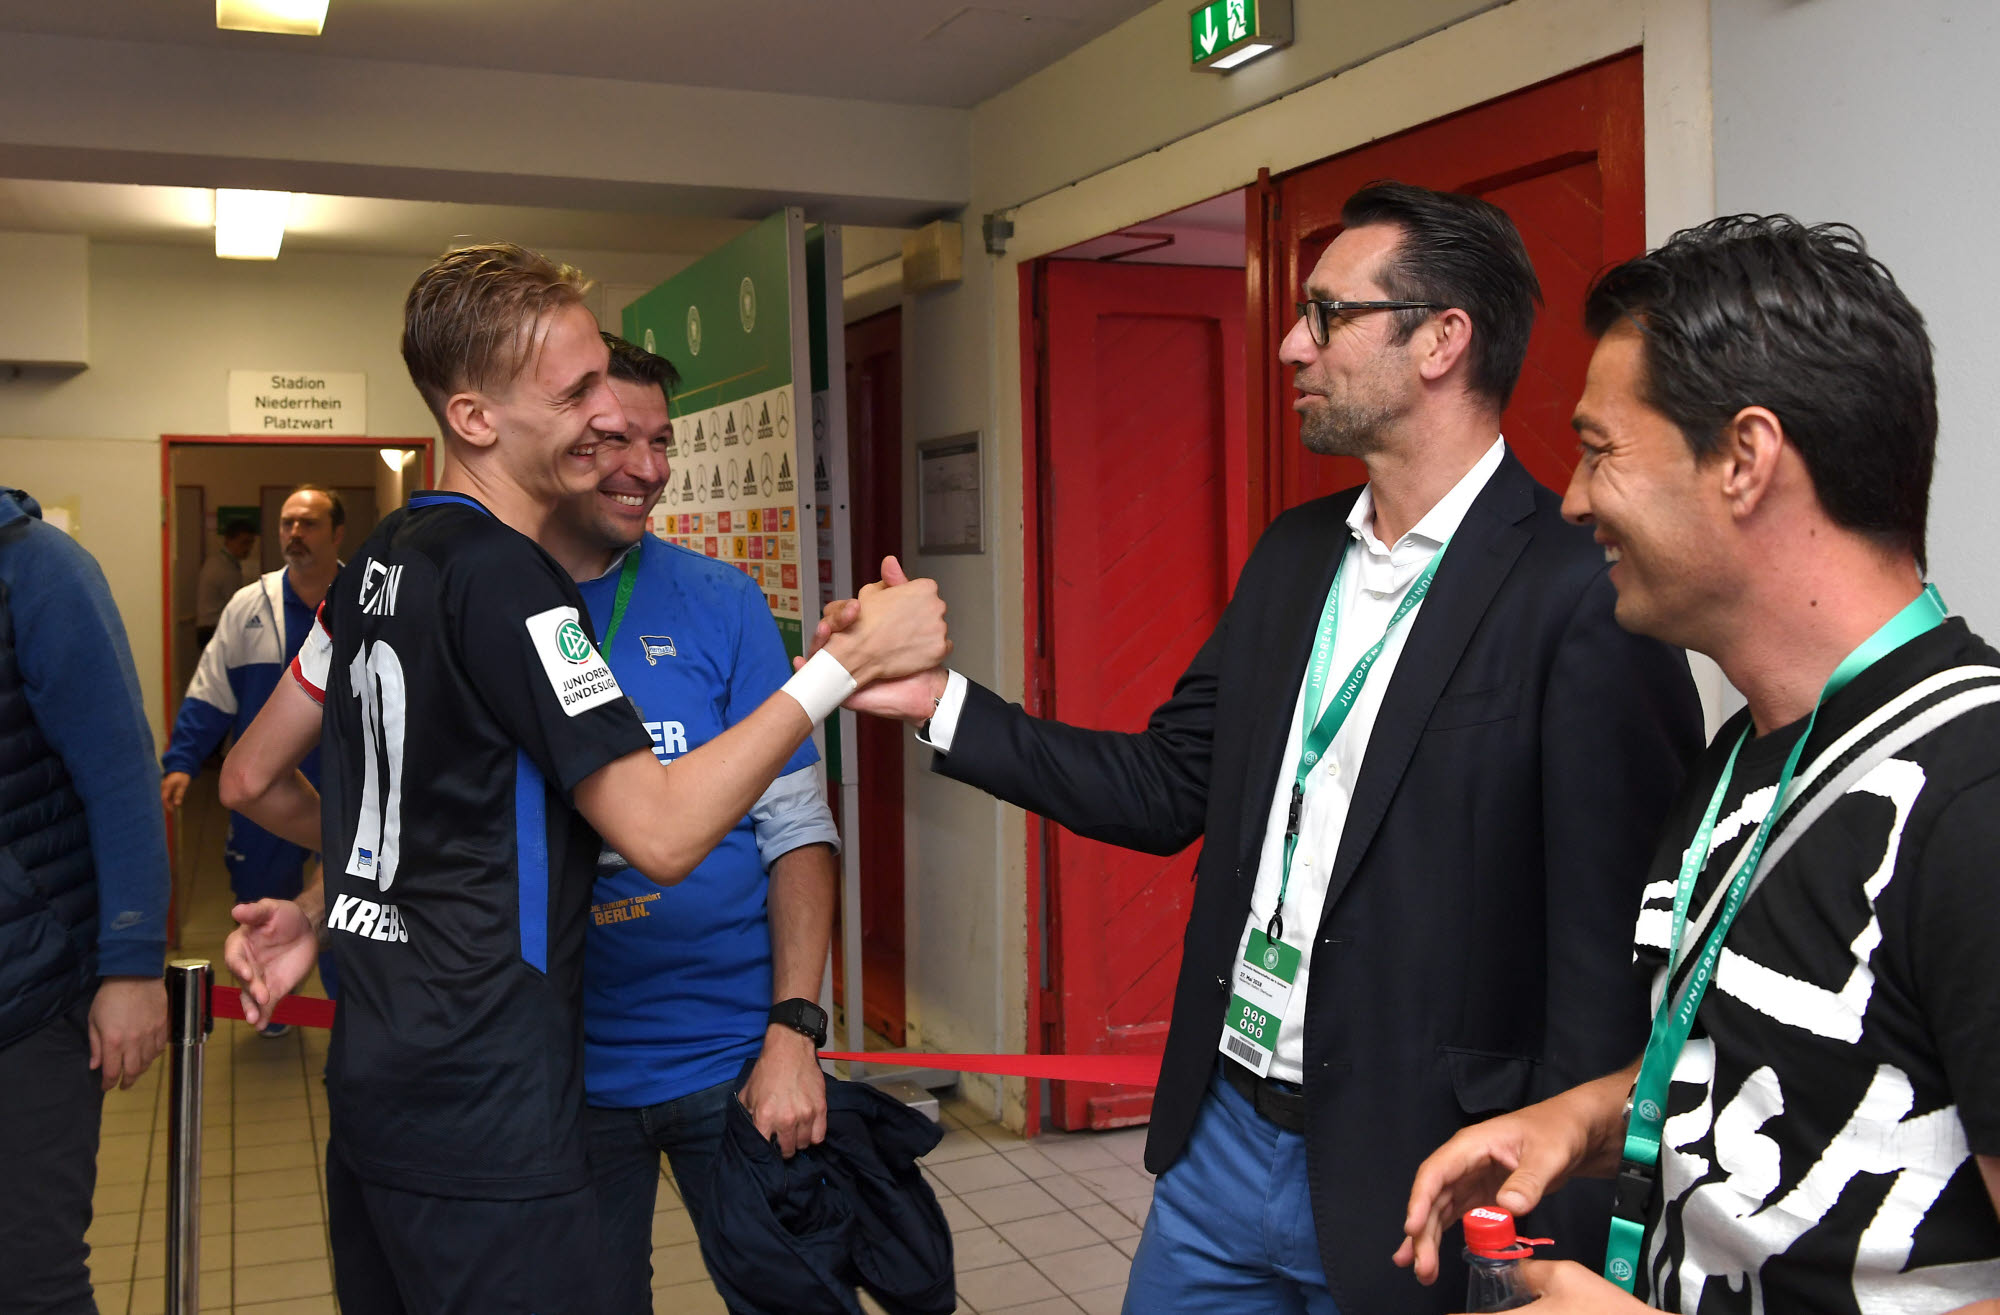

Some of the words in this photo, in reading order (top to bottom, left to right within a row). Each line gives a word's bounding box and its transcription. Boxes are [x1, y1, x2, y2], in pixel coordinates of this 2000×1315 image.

[271, 375, 326, 390] Stadion
[255, 396, 342, 410] Niederrhein
[264, 415, 334, 430] Platzwart
[563, 666, 610, 692] JUNIOREN-
[345, 638, 406, 893] 10
[327, 893, 409, 943] KREBS
[594, 903, 651, 926] BERLIN.
